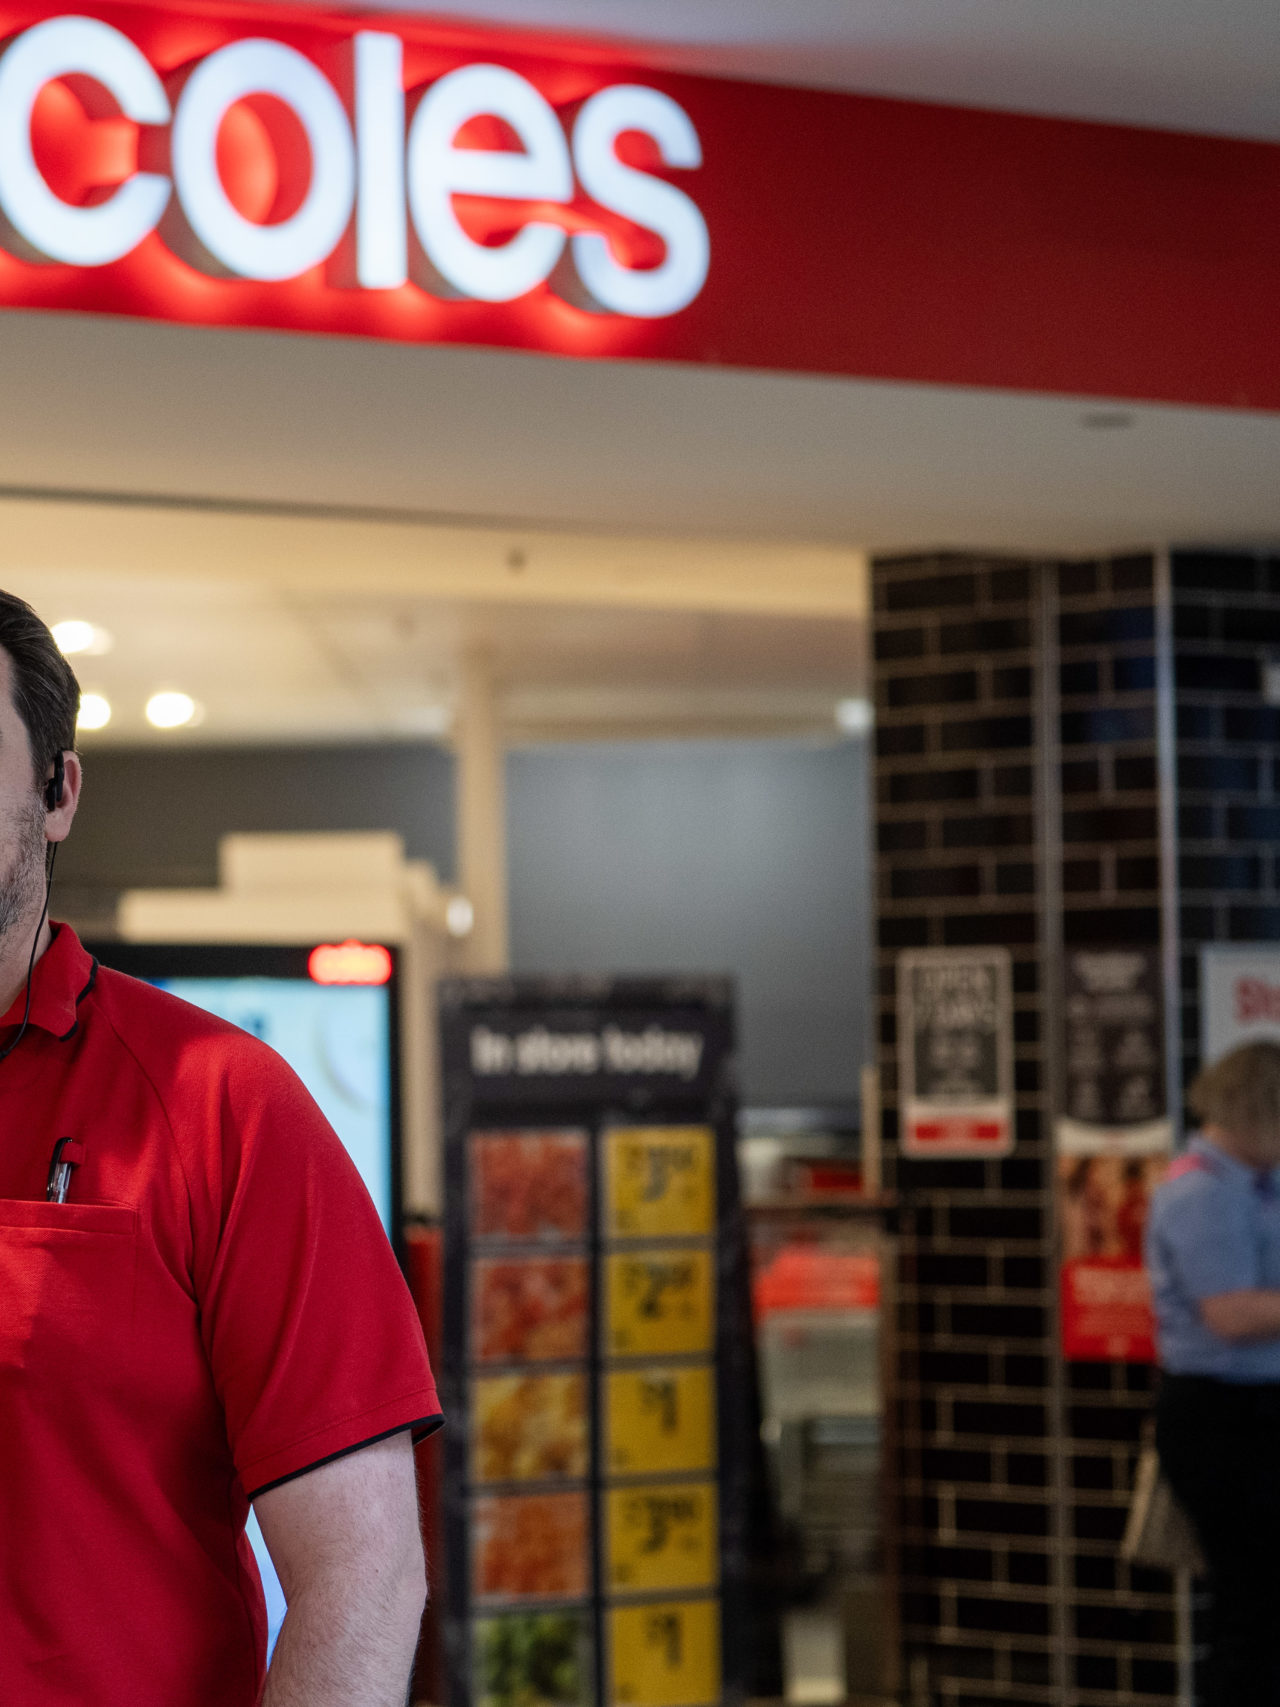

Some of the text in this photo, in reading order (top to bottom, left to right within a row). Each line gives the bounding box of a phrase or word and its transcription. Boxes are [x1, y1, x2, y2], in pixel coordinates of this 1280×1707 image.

[472, 1024, 703, 1080] In store today
